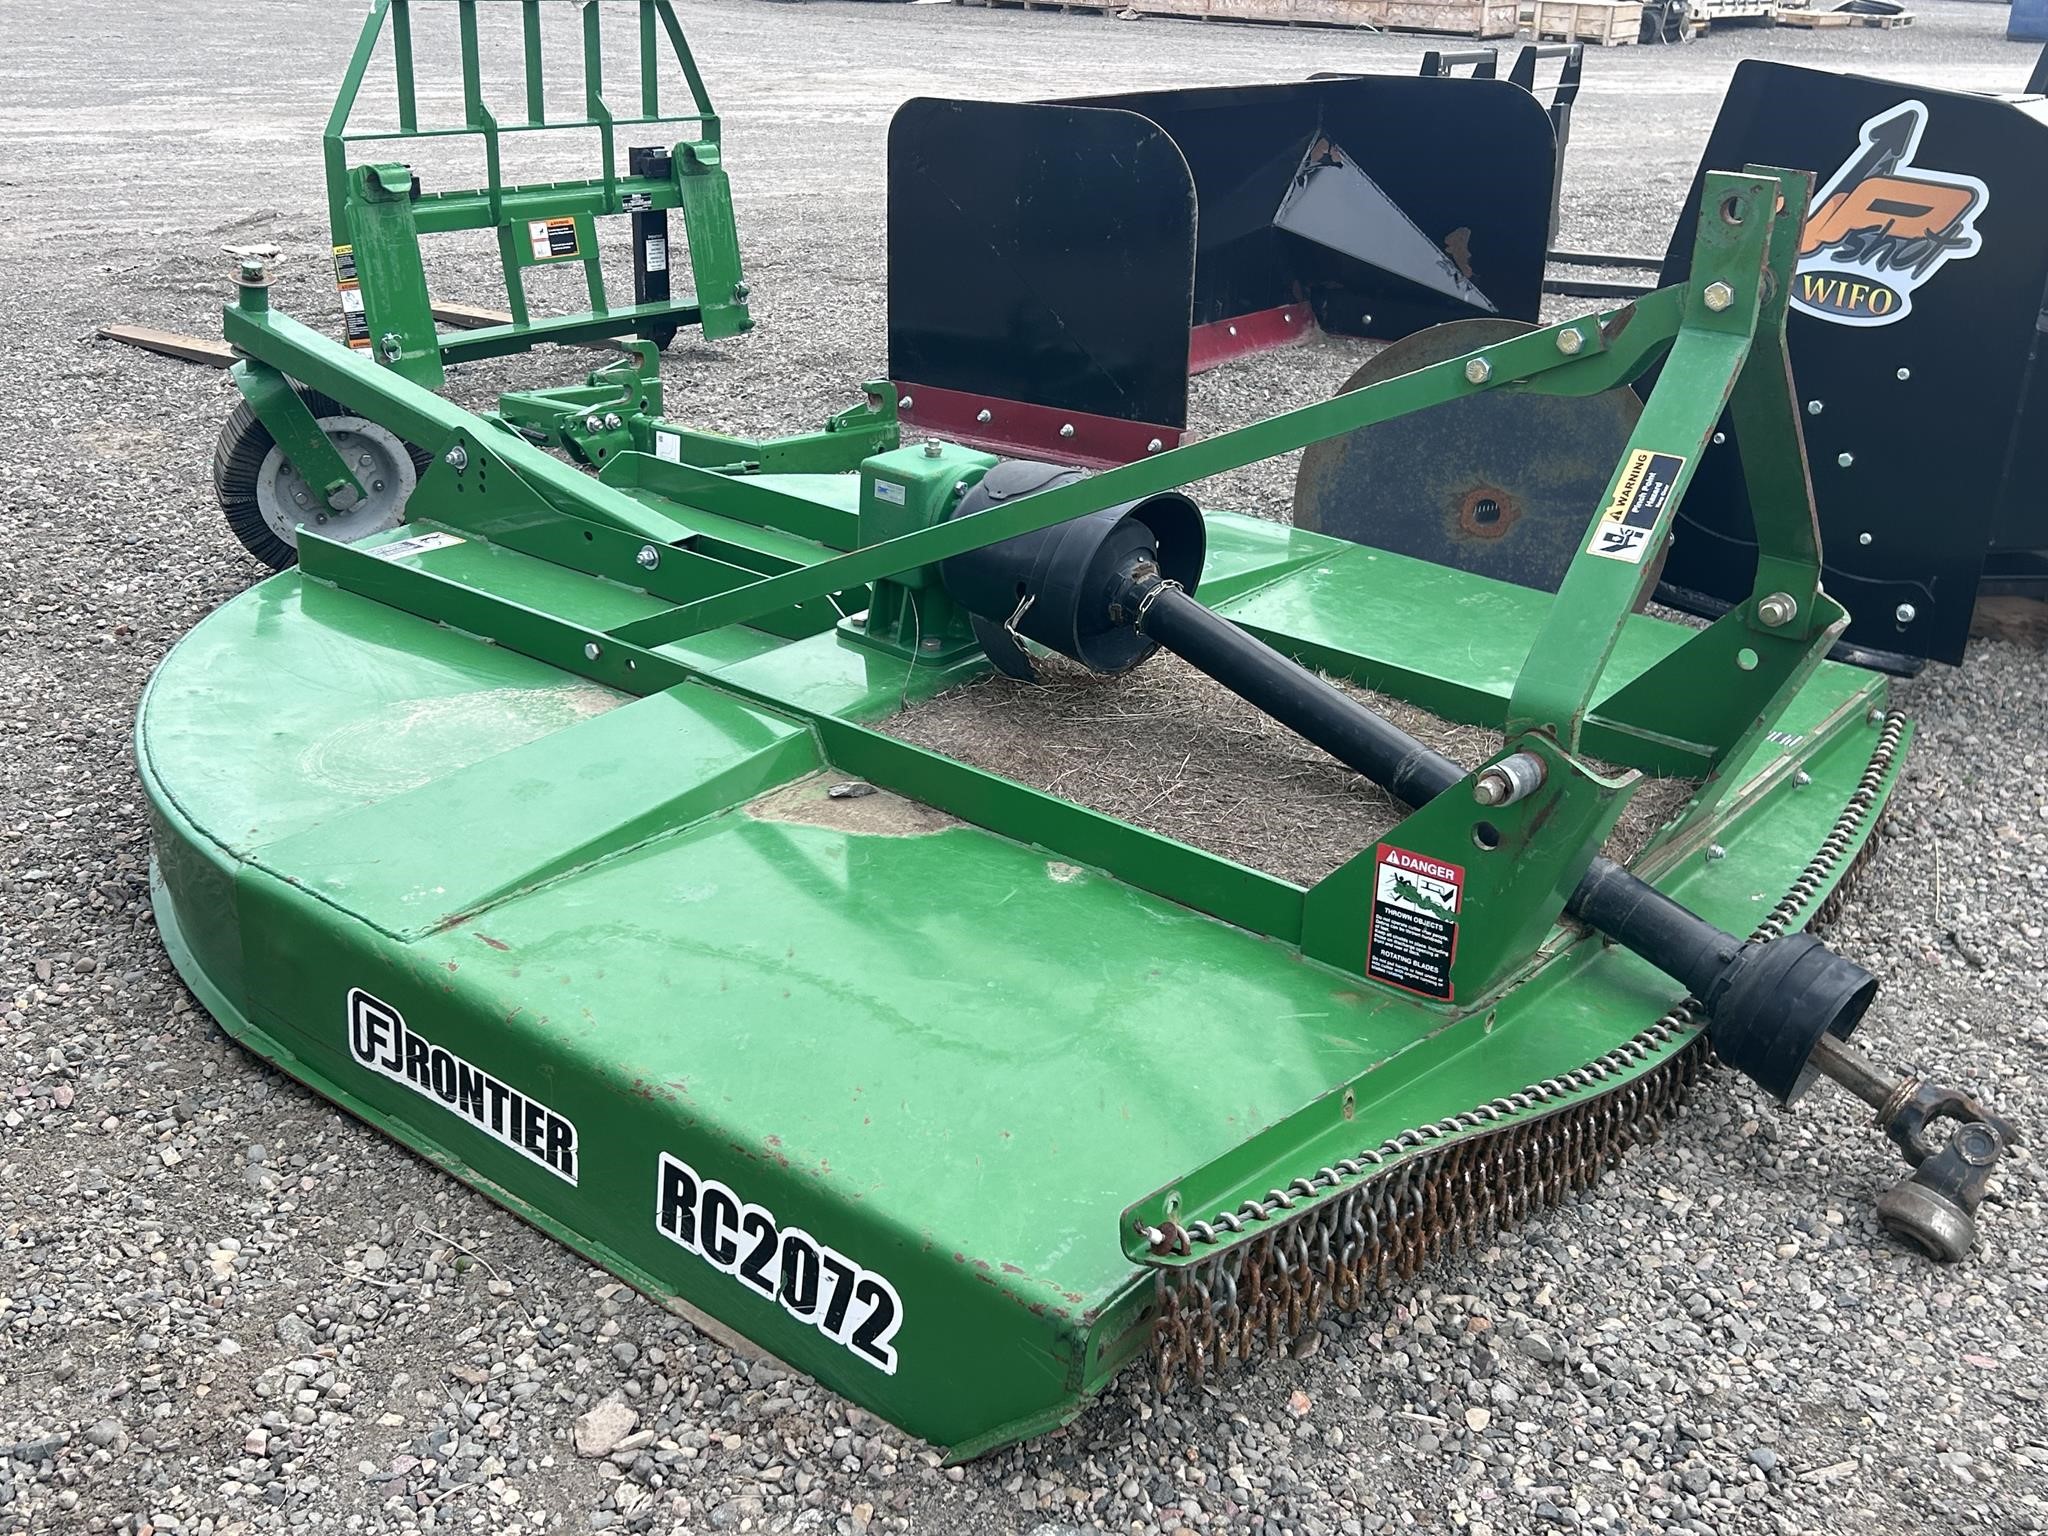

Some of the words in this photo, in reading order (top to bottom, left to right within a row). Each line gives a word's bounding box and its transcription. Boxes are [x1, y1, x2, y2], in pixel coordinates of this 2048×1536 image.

[1830, 218, 1972, 280] shot
[1803, 274, 1893, 315] WIFO
[1616, 454, 1648, 506] WARNING
[1632, 492, 1647, 513] Pinch
[1642, 472, 1657, 492] Point
[1645, 481, 1663, 507] Hazard
[1401, 855, 1455, 880] DANGER
[1385, 908, 1412, 921] THROWN
[1414, 917, 1444, 932] OBJECTS
[1381, 950, 1412, 964] ROTATING
[1413, 960, 1439, 974] BLADES
[353, 989, 578, 1176] FRONTIER
[661, 1160, 896, 1366] RC2072
